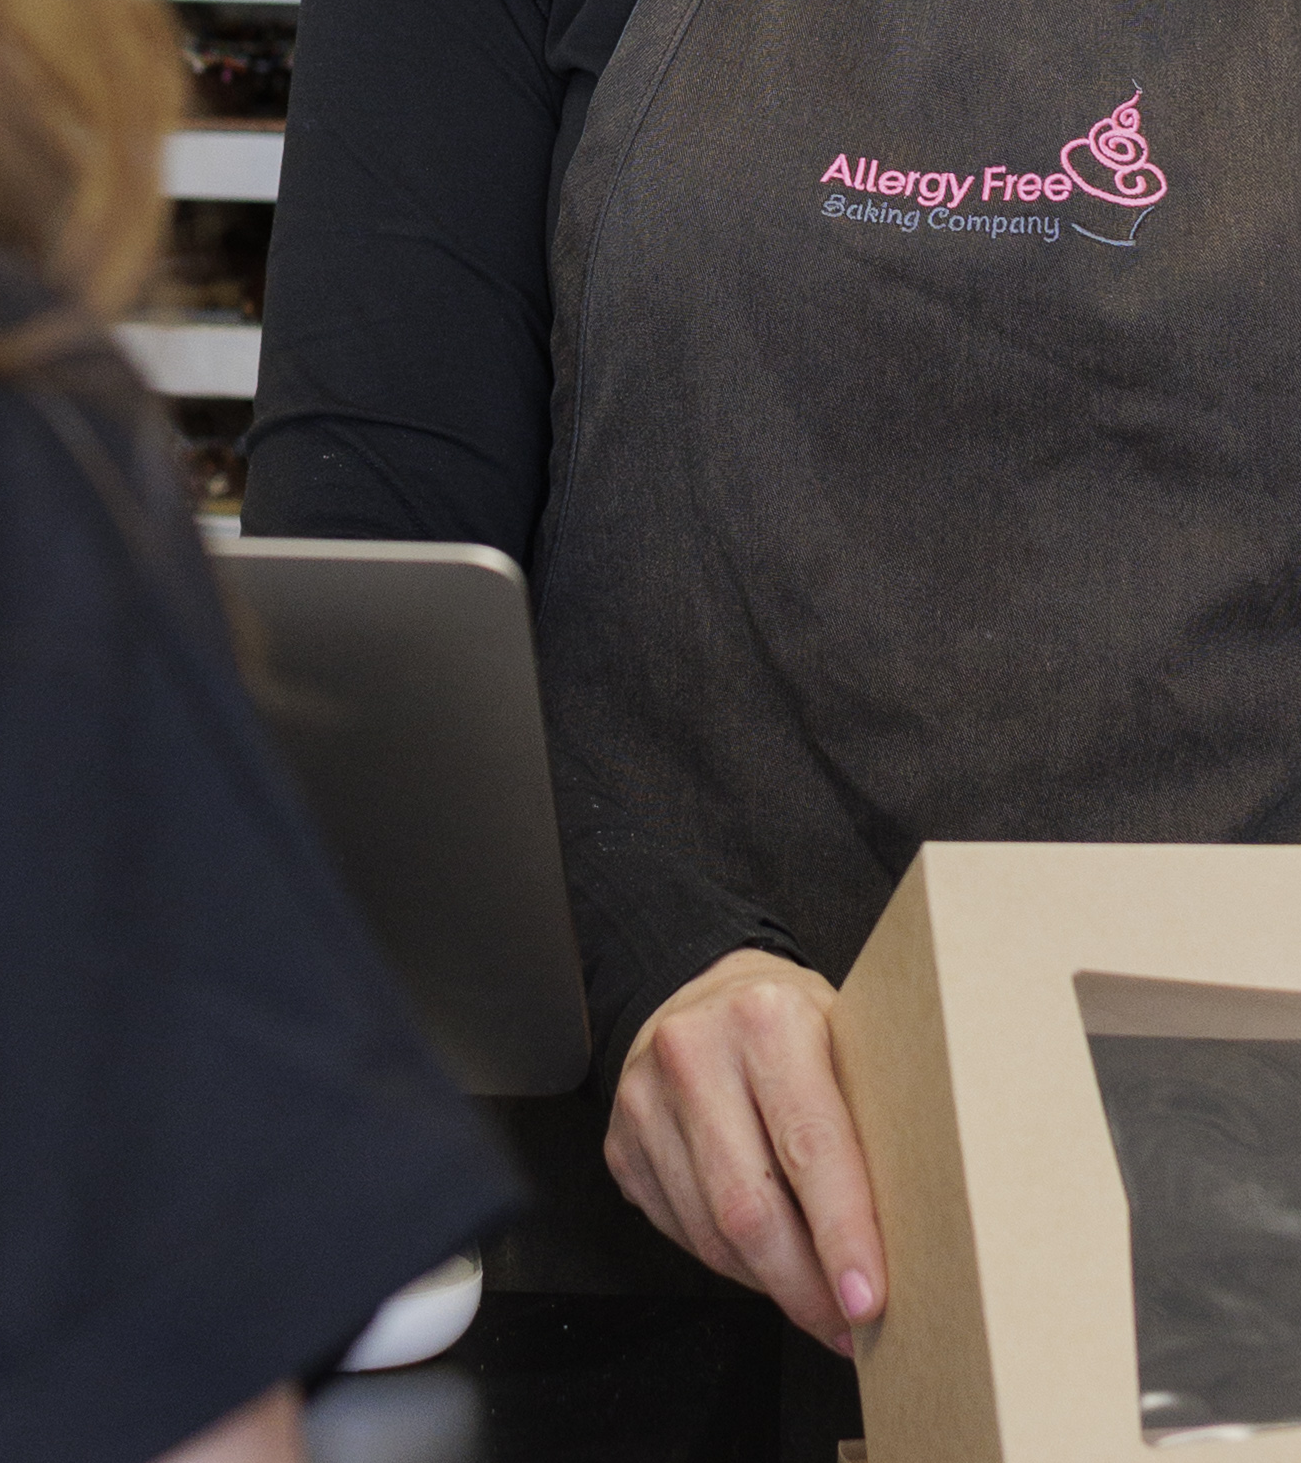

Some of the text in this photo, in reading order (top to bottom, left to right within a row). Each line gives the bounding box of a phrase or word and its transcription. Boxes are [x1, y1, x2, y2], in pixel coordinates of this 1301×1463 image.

[820, 153, 1073, 208] Allergy Free
[821, 194, 1060, 242] Baking Company
